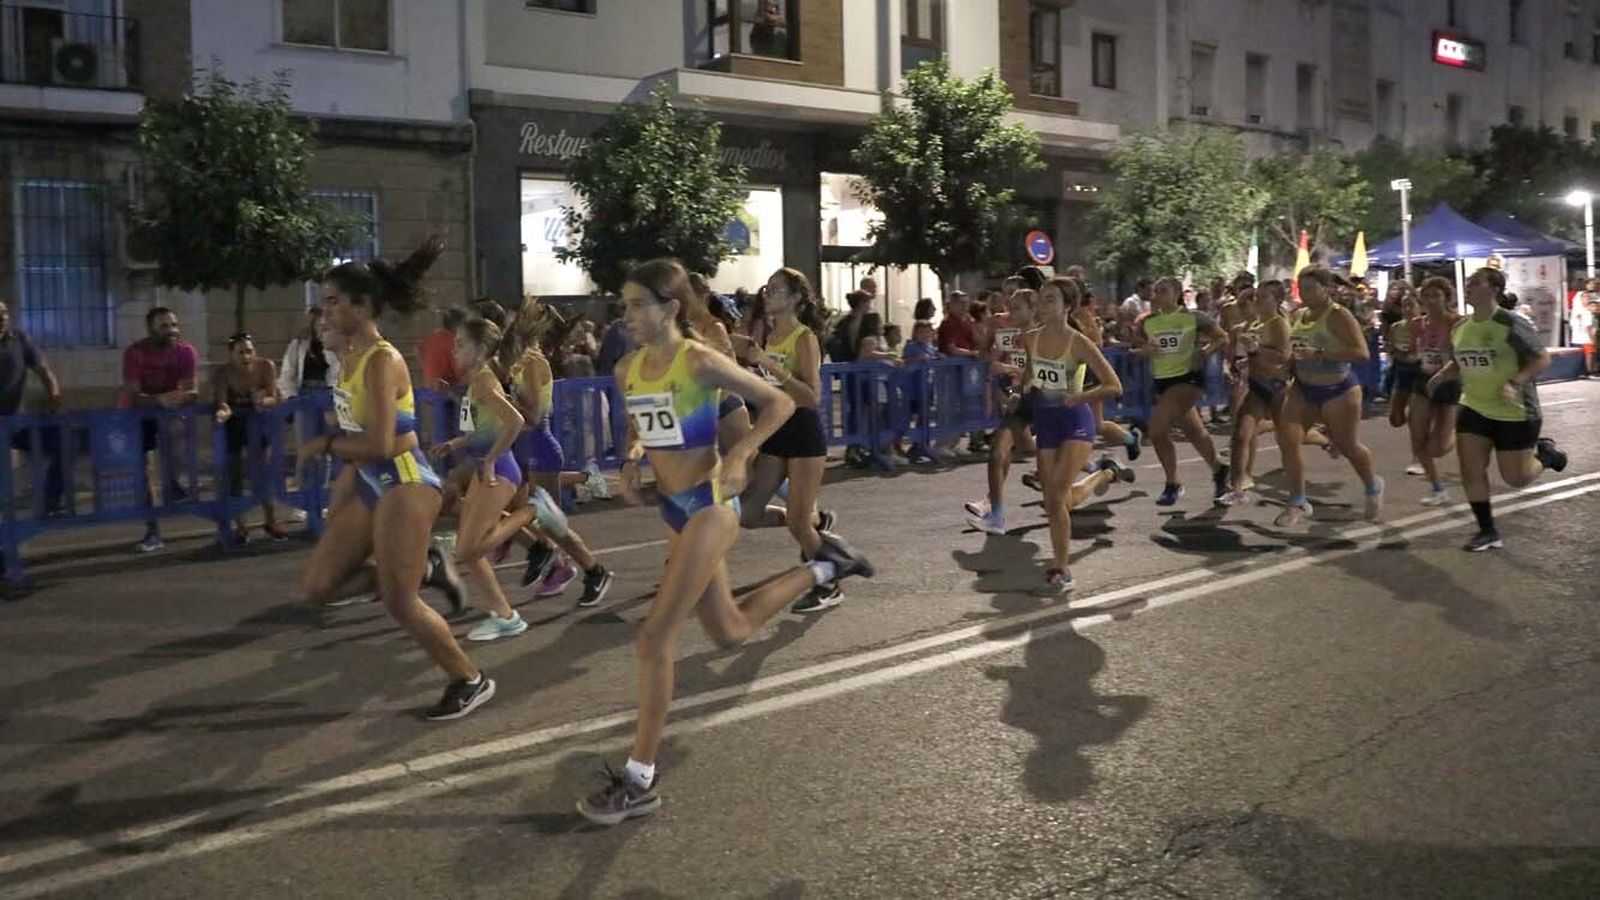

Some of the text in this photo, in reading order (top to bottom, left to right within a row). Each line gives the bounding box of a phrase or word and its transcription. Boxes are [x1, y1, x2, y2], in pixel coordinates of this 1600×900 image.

[1160, 336, 1178, 348] 99
[1460, 356, 1489, 367] 179
[1037, 368, 1059, 383] 40
